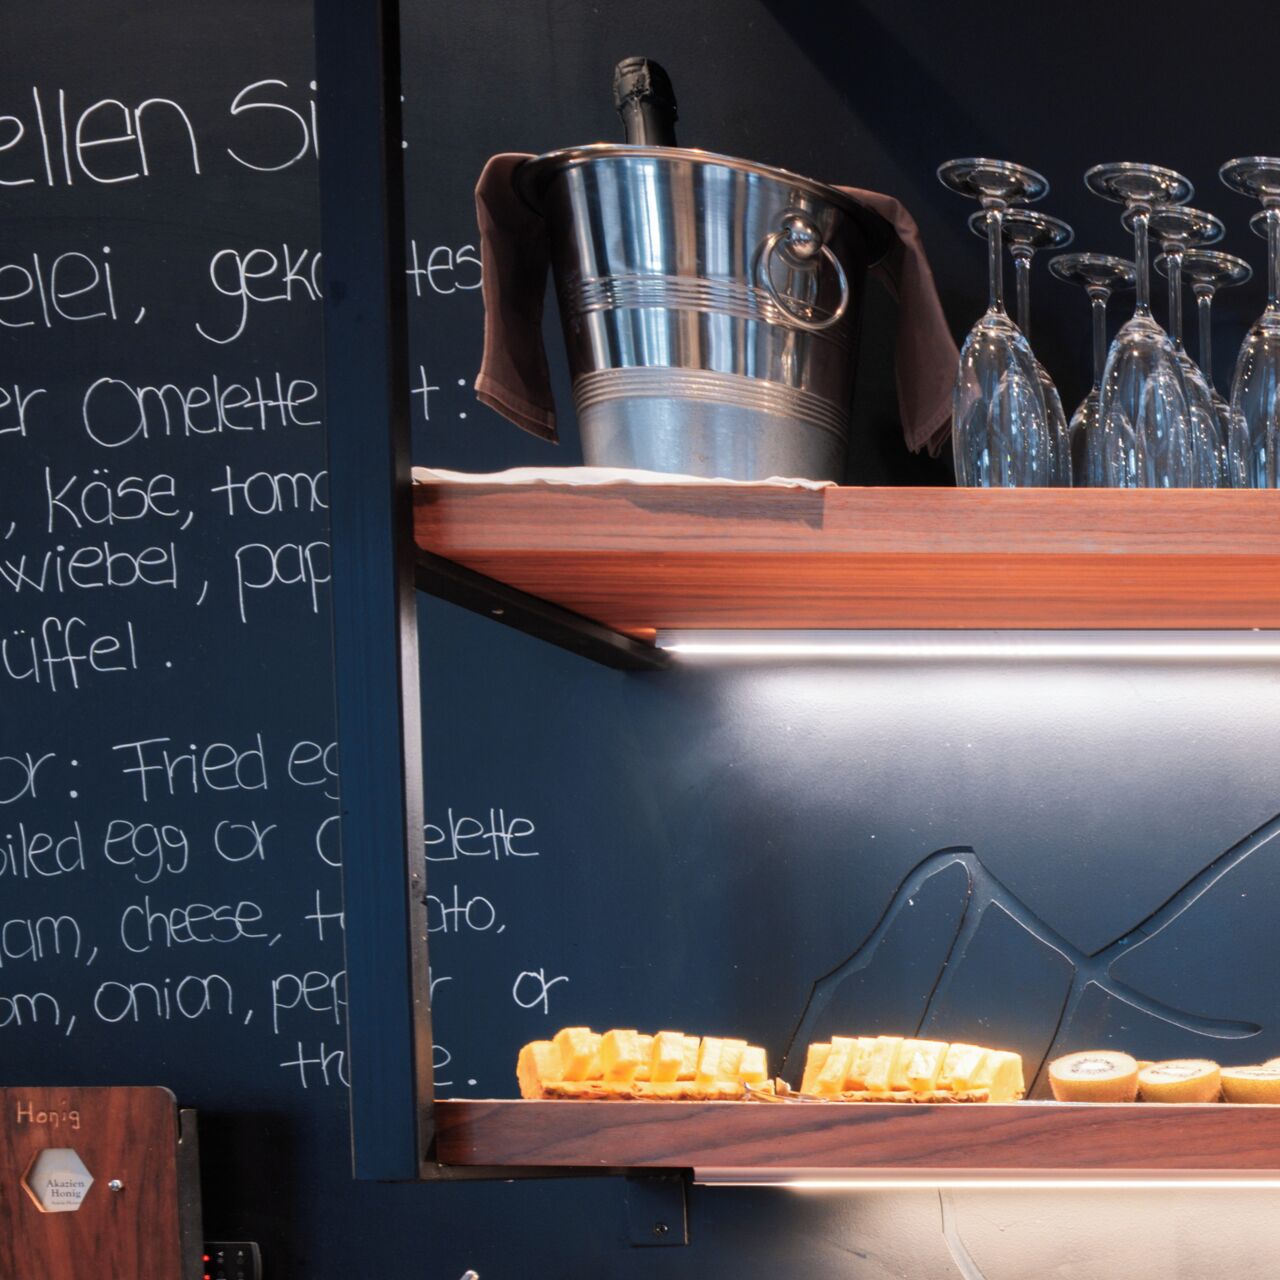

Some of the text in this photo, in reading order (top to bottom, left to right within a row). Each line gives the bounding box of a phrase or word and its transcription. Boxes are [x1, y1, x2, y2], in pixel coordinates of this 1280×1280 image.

[83, 373, 321, 447] Omelette
[112, 732, 267, 802] Fried
[104, 819, 189, 884] egg
[214, 820, 278, 861] or
[121, 895, 282, 952] cheese,
[94, 975, 253, 1025] onion,
[513, 967, 569, 1016] or
[17, 1099, 81, 1130] Honig
[51, 1188, 82, 1199] Honig
